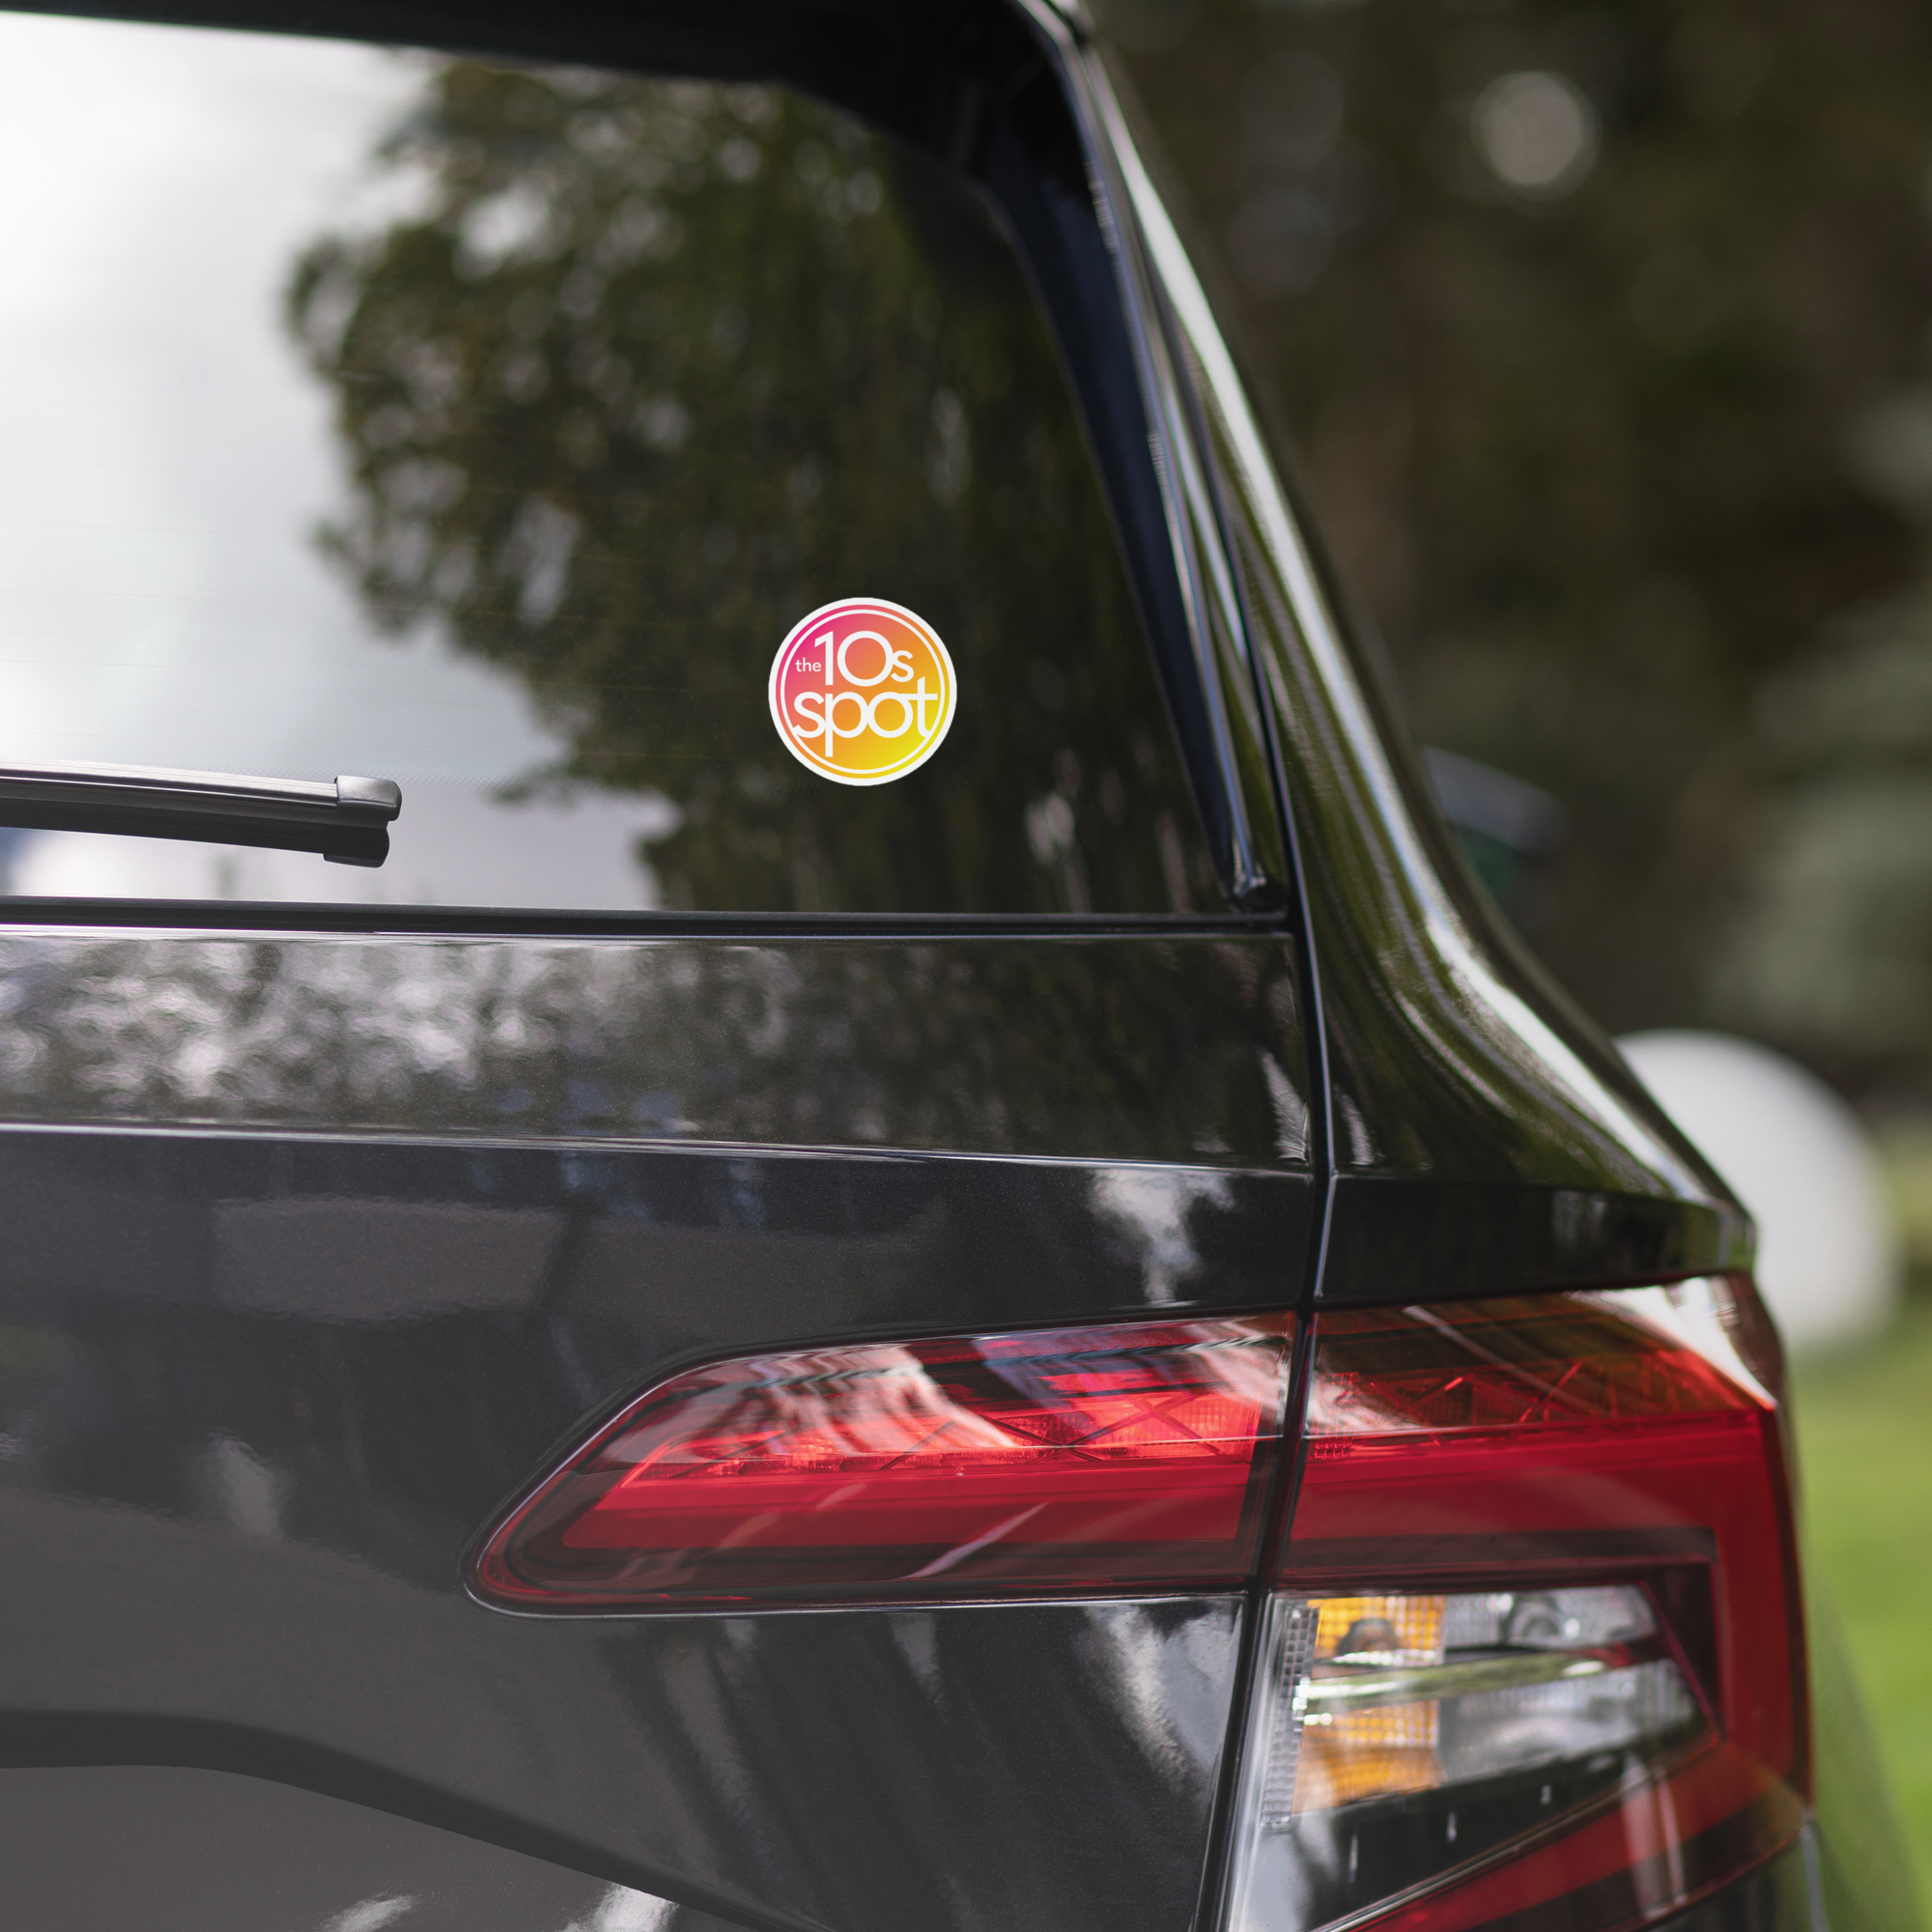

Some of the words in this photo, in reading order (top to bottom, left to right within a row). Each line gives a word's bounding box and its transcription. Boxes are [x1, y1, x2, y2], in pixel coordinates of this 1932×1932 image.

[795, 657, 821, 672] the
[814, 630, 914, 687] 10s
[793, 676, 938, 757] spot
